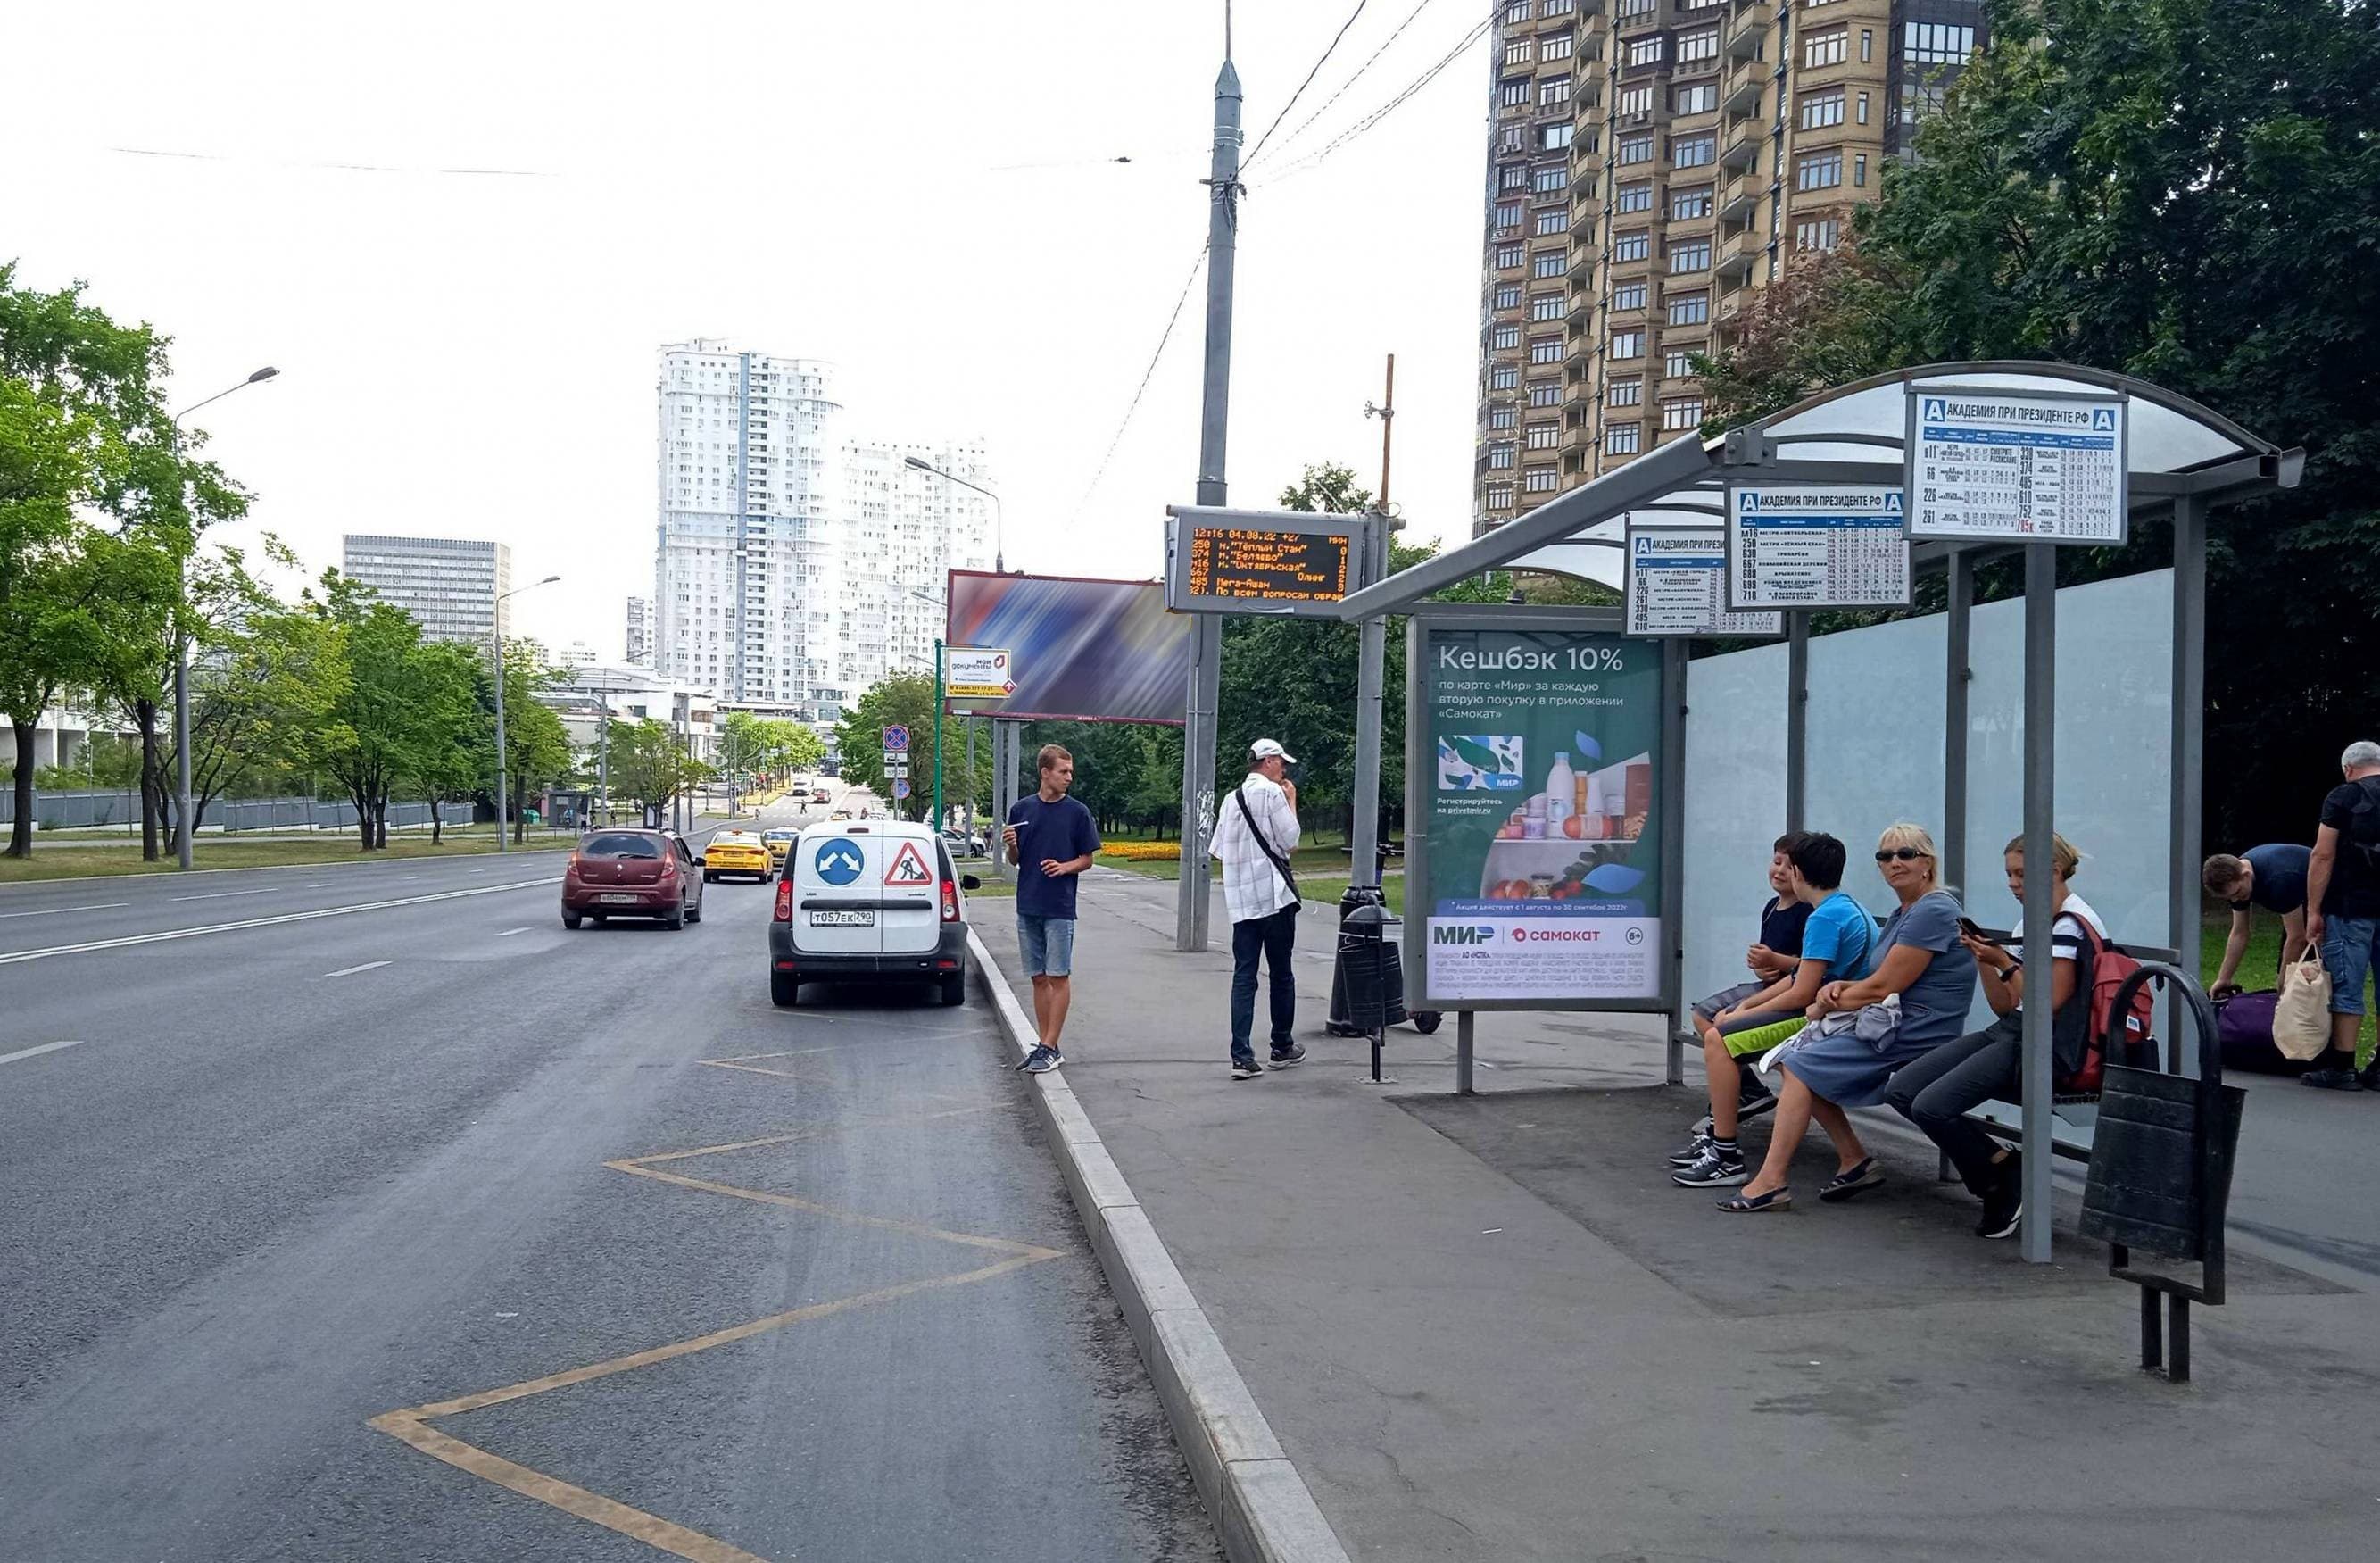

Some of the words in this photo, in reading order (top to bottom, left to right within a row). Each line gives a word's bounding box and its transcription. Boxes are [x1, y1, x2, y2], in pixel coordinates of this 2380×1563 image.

[1947, 403, 1995, 420] АКАДЕМИЯ
[1999, 407, 2016, 419] ПРИ
[2018, 408, 2072, 423] ПРЕЗИДЕНТЕ
[2075, 412, 2089, 424] РФ
[1928, 466, 1936, 480] 66
[2019, 461, 2033, 475] 374
[1924, 488, 1936, 502] 226
[2019, 490, 2032, 504] 610
[1760, 495, 1801, 508] АКАДЕМИЯ
[1803, 495, 1819, 506] ПРИ
[1820, 495, 1868, 508] ПРЕЗИДЕНТЕ
[1870, 495, 1882, 507] РФ
[1923, 510, 1936, 524] 261
[2019, 505, 2032, 519] 752
[1195, 528, 1223, 538] 12:16
[1229, 529, 1276, 541] 04.08.22
[1192, 539, 1211, 549] 250
[1653, 540, 1688, 550] АКАДЕМИЯ
[1689, 540, 1703, 549] ПРИ
[1742, 538, 1756, 548] 250
[1742, 549, 1756, 558] 630
[1339, 565, 1346, 574] 2
[1742, 559, 1756, 569] 667
[1339, 574, 1346, 583] 2
[1742, 569, 1756, 578] 688
[1636, 586, 1649, 594] 226
[1742, 580, 1756, 589] 699
[1216, 586, 1229, 596] По
[1636, 595, 1647, 604] 261
[1439, 645, 1558, 670] Кешбэк
[1566, 647, 1623, 671] 10%
[1439, 681, 1455, 690] по
[1457, 681, 1491, 694] карте
[1494, 681, 1532, 694] «Мир»
[1535, 682, 1548, 691] за
[1552, 683, 1599, 694] каждую
[1439, 695, 1484, 707] вторую
[1487, 696, 1535, 707] покупку
[1538, 697, 1546, 705] в
[1549, 697, 1624, 708] приложении
[1439, 708, 1502, 719] «Самокат»
[1437, 797, 1504, 806] Регистрируйтесь
[1433, 926, 1495, 944] МИР
[1530, 930, 1601, 941] самокат
[1629, 932, 1640, 940] 6+
